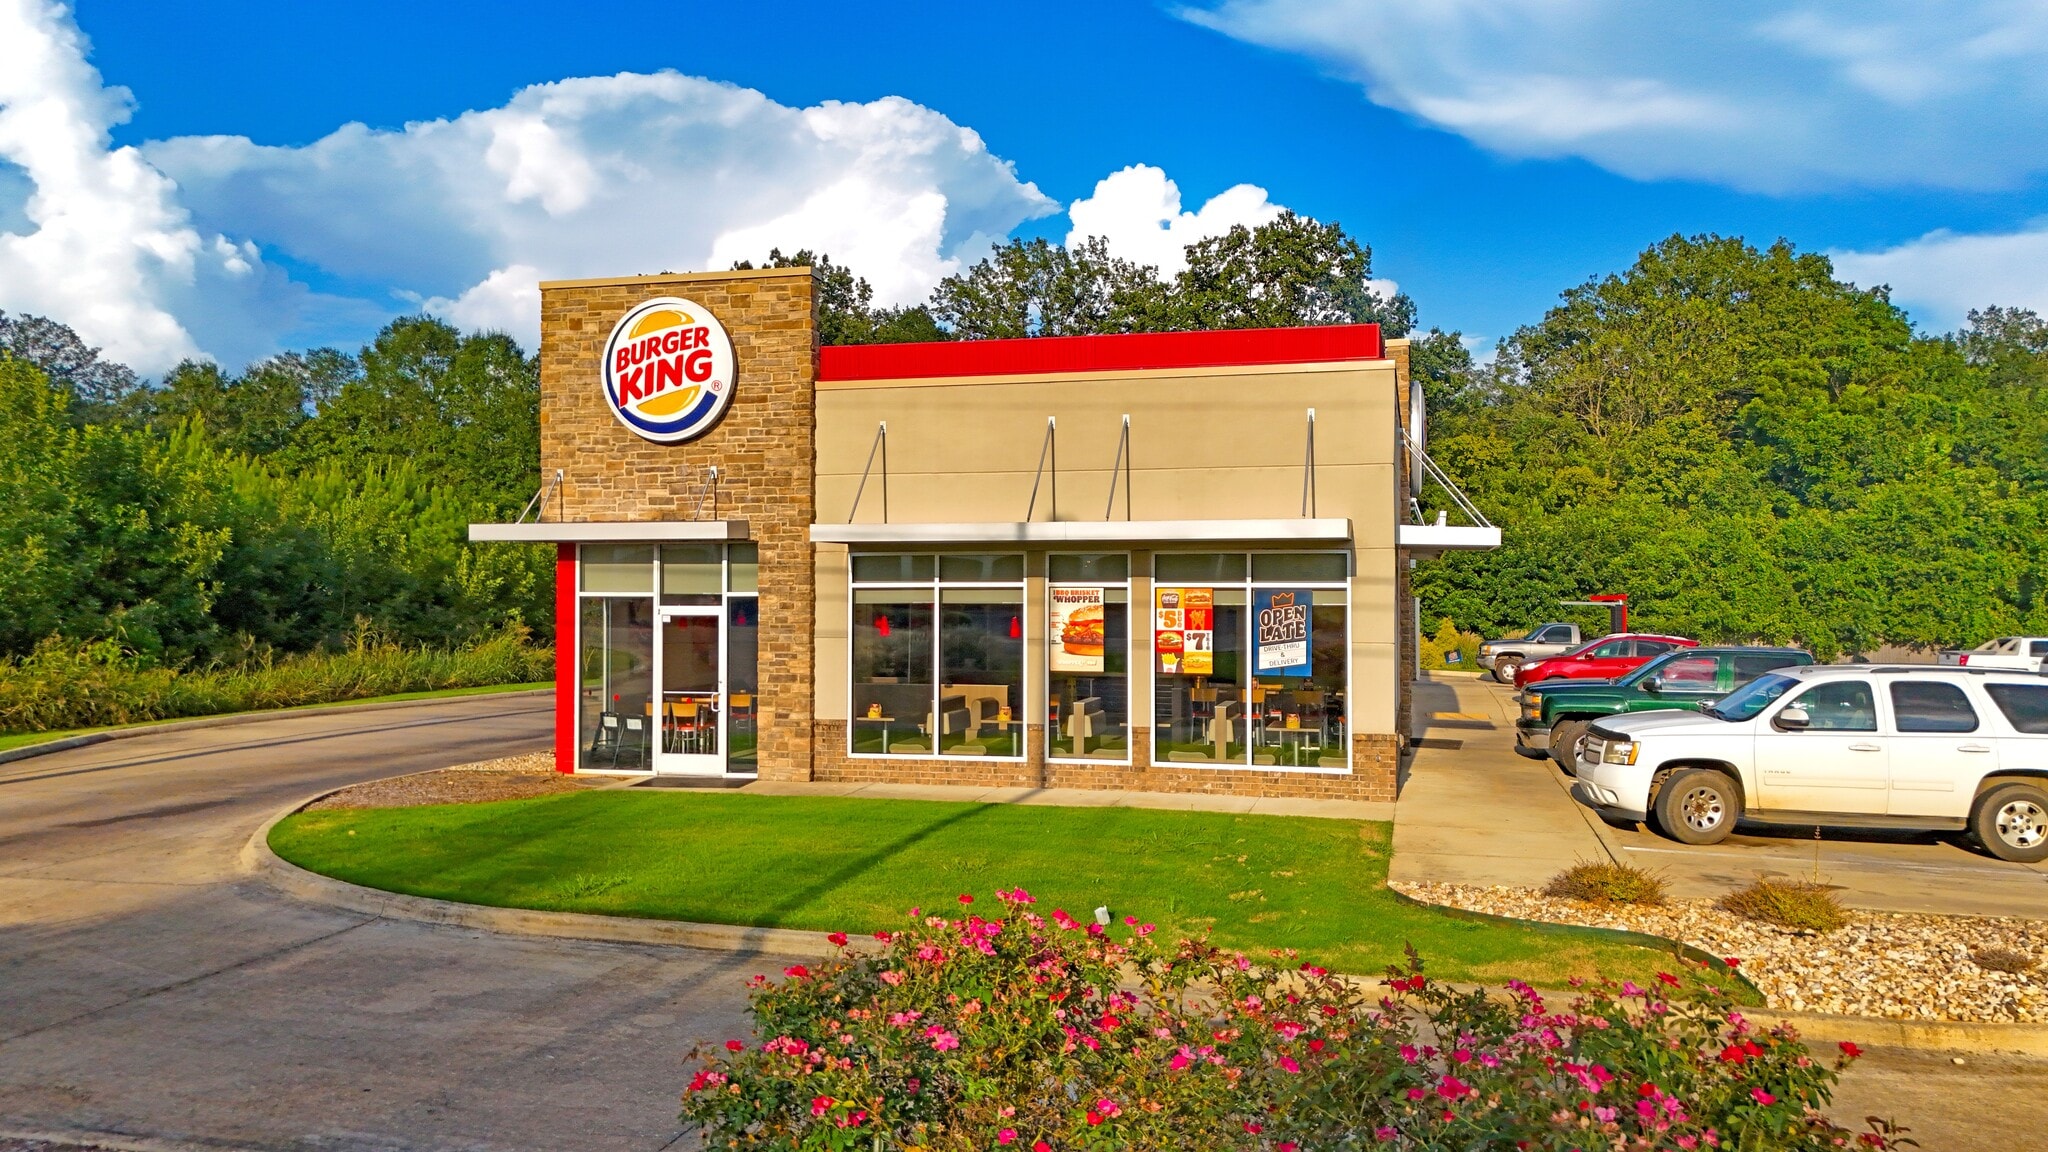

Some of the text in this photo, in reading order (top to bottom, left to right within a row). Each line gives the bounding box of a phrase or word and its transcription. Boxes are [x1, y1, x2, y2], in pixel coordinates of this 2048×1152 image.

[616, 326, 709, 374] BURGER
[619, 349, 713, 409] KING
[1054, 595, 1100, 603] WHOPPER
[1158, 610, 1177, 628] $5
[1259, 605, 1306, 627] OPEN
[1259, 620, 1306, 642] LATE
[1186, 632, 1205, 650] $7
[1263, 643, 1300, 653] DRIVE-THRU
[1269, 658, 1299, 667] DELIVERY
